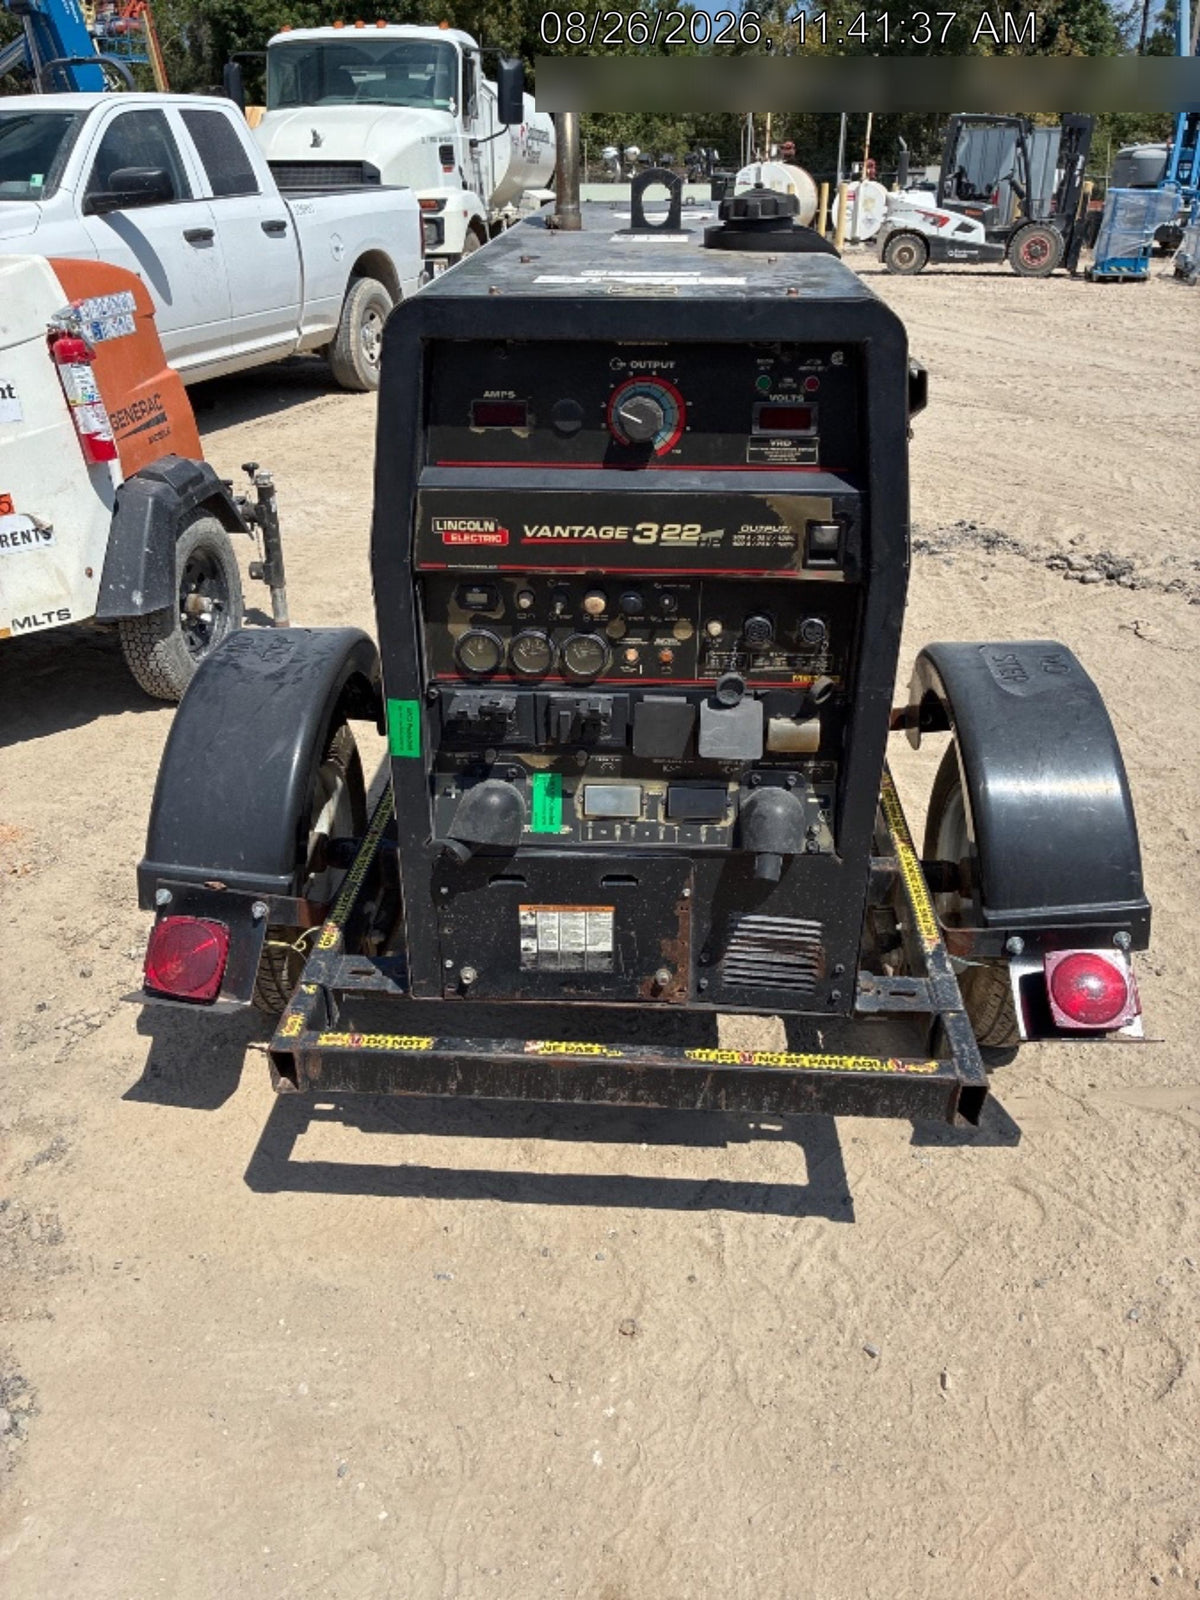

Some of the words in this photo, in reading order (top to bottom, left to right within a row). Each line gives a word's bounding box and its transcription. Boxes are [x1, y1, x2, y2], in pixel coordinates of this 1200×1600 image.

[630, 361, 676, 369] OUTPUT
[482, 390, 516, 399] AMPS
[769, 394, 805, 402] VOLTS
[109, 393, 162, 430] GENERAC
[435, 520, 495, 532] LINCOLN
[450, 532, 503, 543] ELECTRIC
[523, 524, 631, 540] VANTAGE
[632, 522, 703, 545] 322
[12, 608, 72, 632] MLTS
[366, 1037, 388, 1046] DO
[391, 1038, 424, 1047] NOT
[716, 1052, 736, 1061] ICI
[758, 1055, 781, 1064] NO
[808, 1057, 847, 1067] PARE
